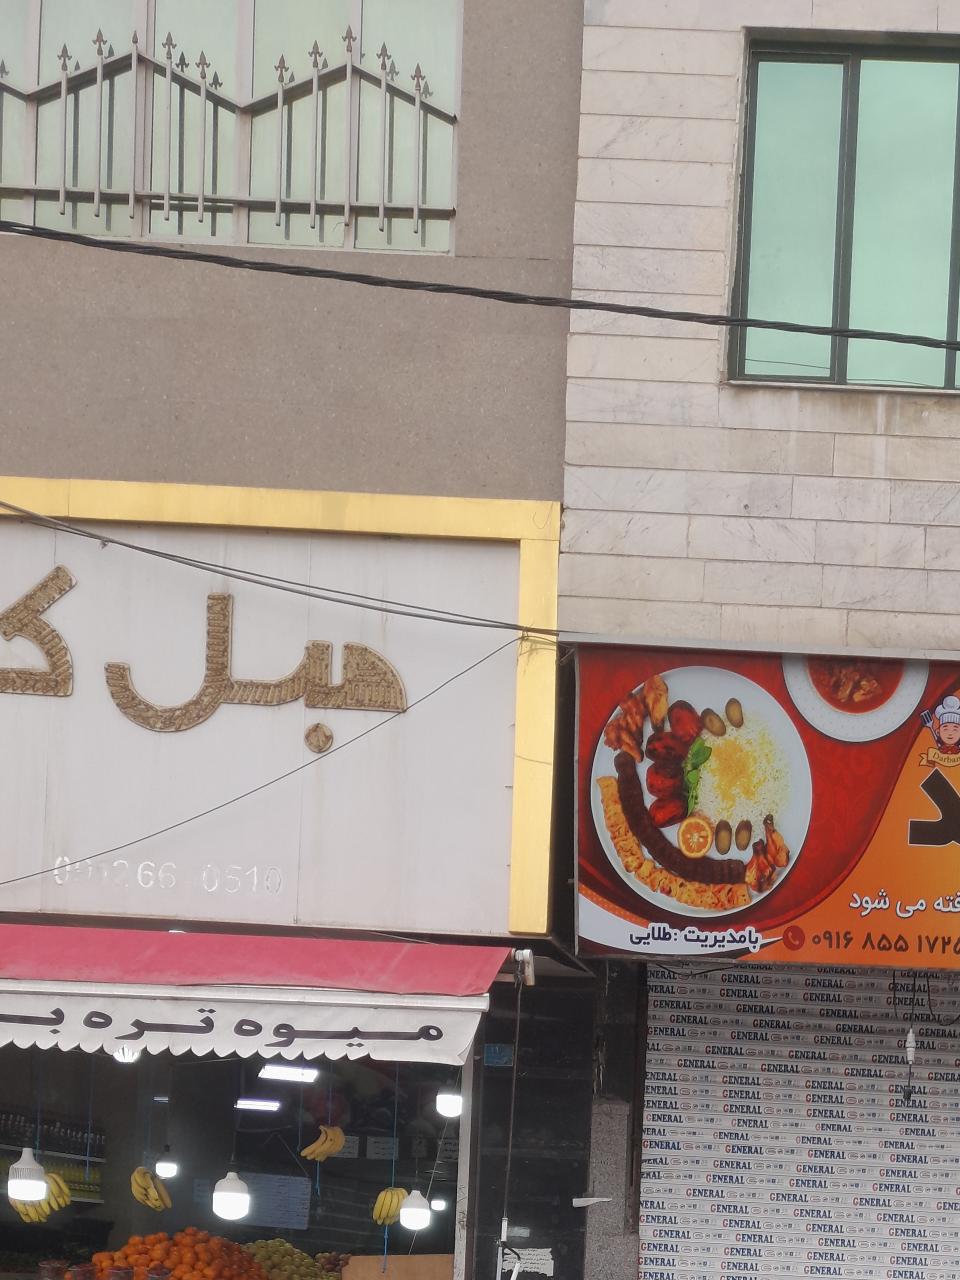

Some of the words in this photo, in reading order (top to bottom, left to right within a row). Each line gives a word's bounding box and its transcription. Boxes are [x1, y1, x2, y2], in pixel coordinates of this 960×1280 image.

[849, 889, 890, 918] شود
[896, 897, 926, 919] می
[861, 932, 909, 953] ۸۵۵
[721, 973, 760, 984] GENERAL
[82, 1008, 216, 1041] تره
[233, 1018, 443, 1048] میوه
[730, 1030, 769, 1041] GENERAL
[705, 1045, 744, 1056] GENERAL
[677, 1058, 716, 1069] GENERAL
[844, 1067, 883, 1078] GENERAL
[722, 1089, 761, 1100] GENERAL
[805, 1093, 844, 1104] GENERAL
[806, 1108, 845, 1119] GENERAL
[889, 1153, 928, 1164] GENERAL
[789, 1178, 828, 1189] GENERAL
[872, 1182, 911, 1193] GENERAL
[710, 1203, 749, 1214] GENERAL
[793, 1208, 832, 1219] GENERAL
[876, 1212, 915, 1223] GENERAL
[652, 1228, 691, 1239] GENERAL
[735, 1233, 774, 1244] GENERAL
[722, 1218, 761, 1229] GENERAL
[888, 1227, 927, 1238] GENERAL
[886, 1269, 925, 1280] GENERAL
